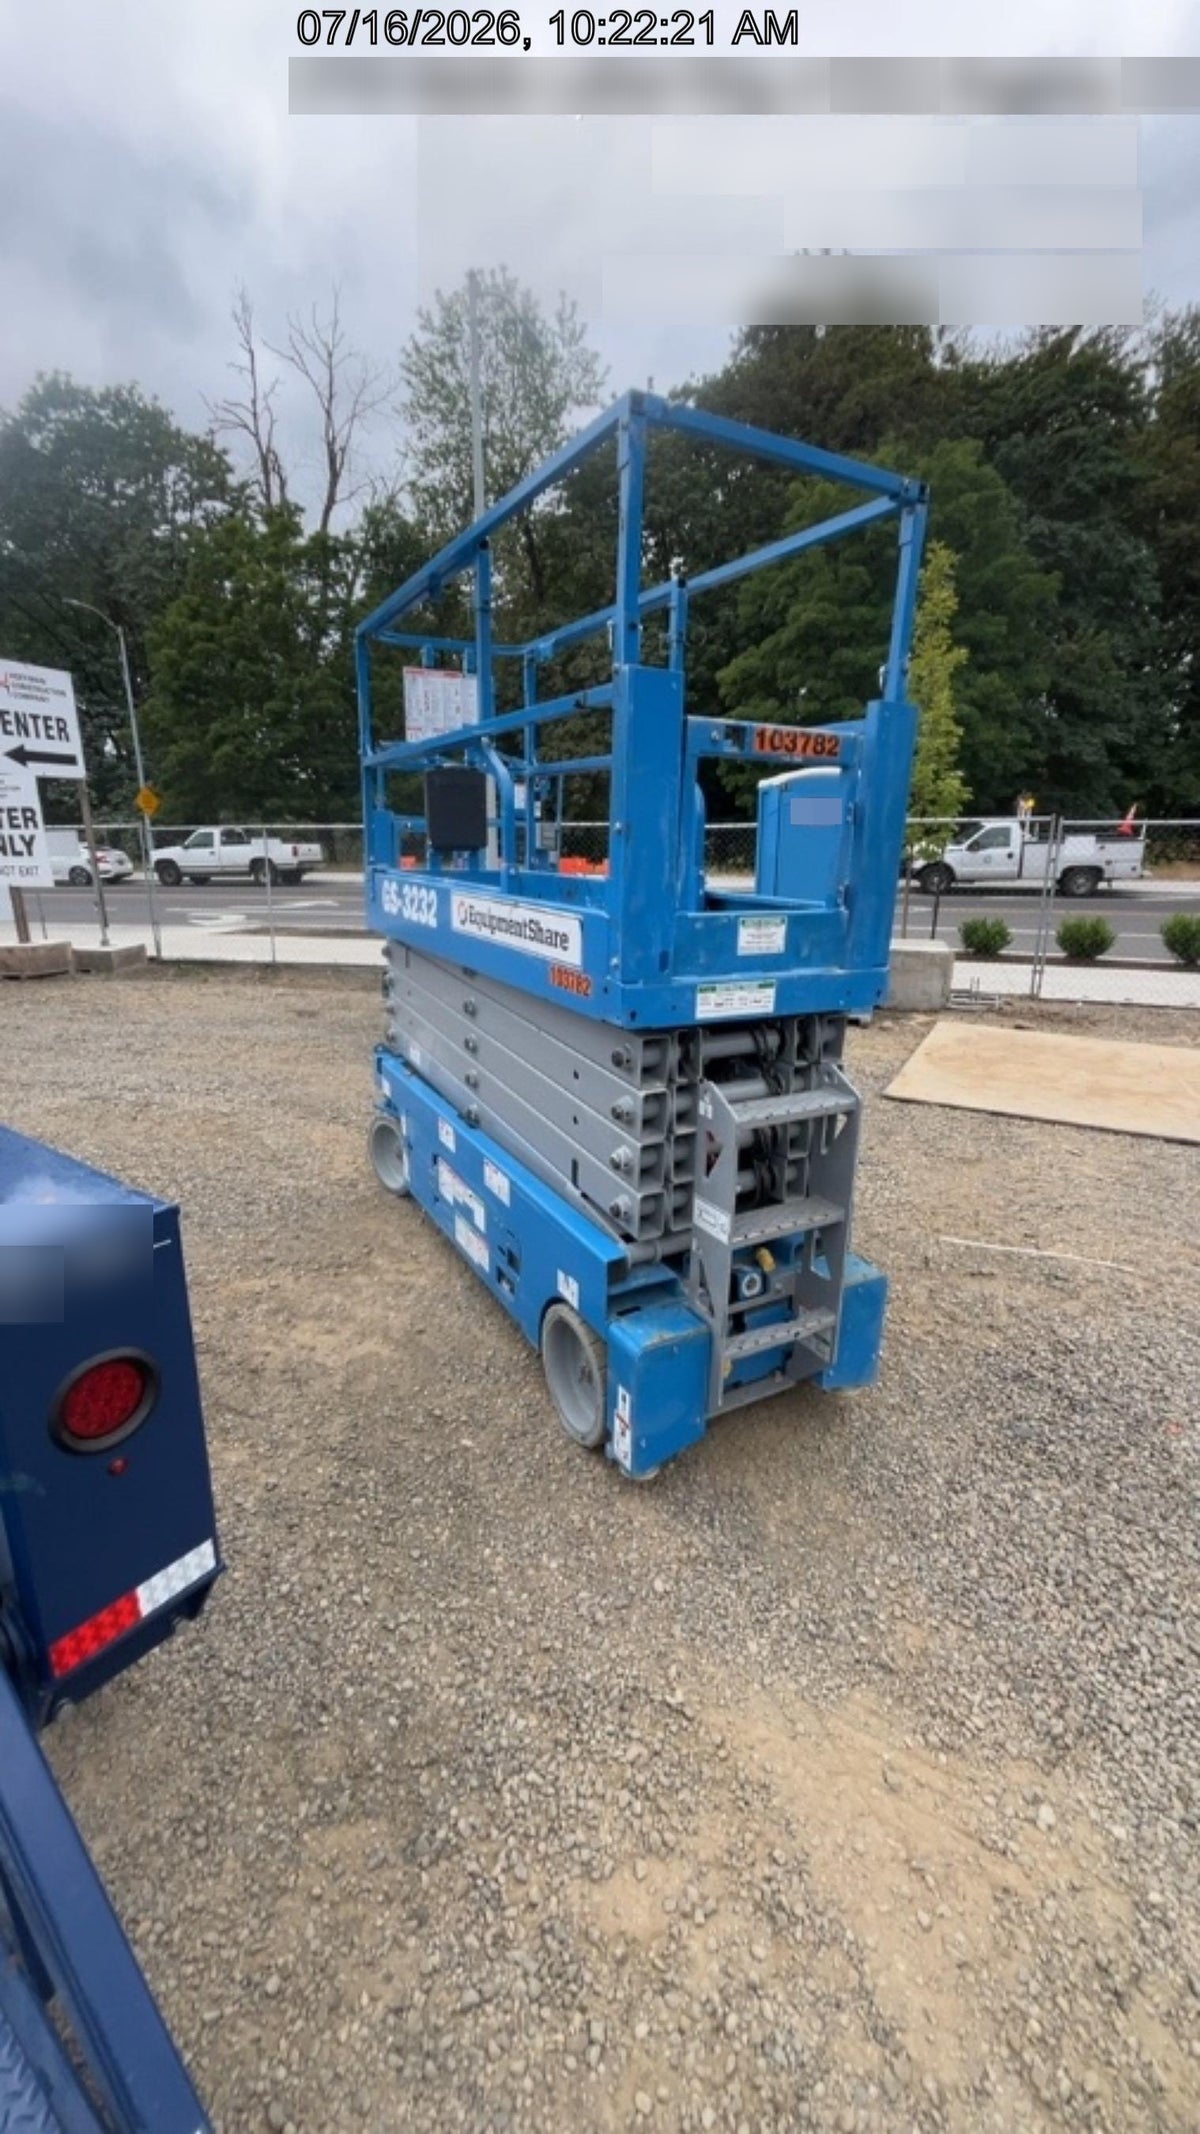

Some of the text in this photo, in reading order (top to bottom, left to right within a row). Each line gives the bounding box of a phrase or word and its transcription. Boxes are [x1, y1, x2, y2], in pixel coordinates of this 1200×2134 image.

[0, 708, 70, 743] ENTER
[755, 727, 839, 757] 103782
[381, 879, 438, 928] GS-3232
[468, 904, 570, 952] EquipmentShare
